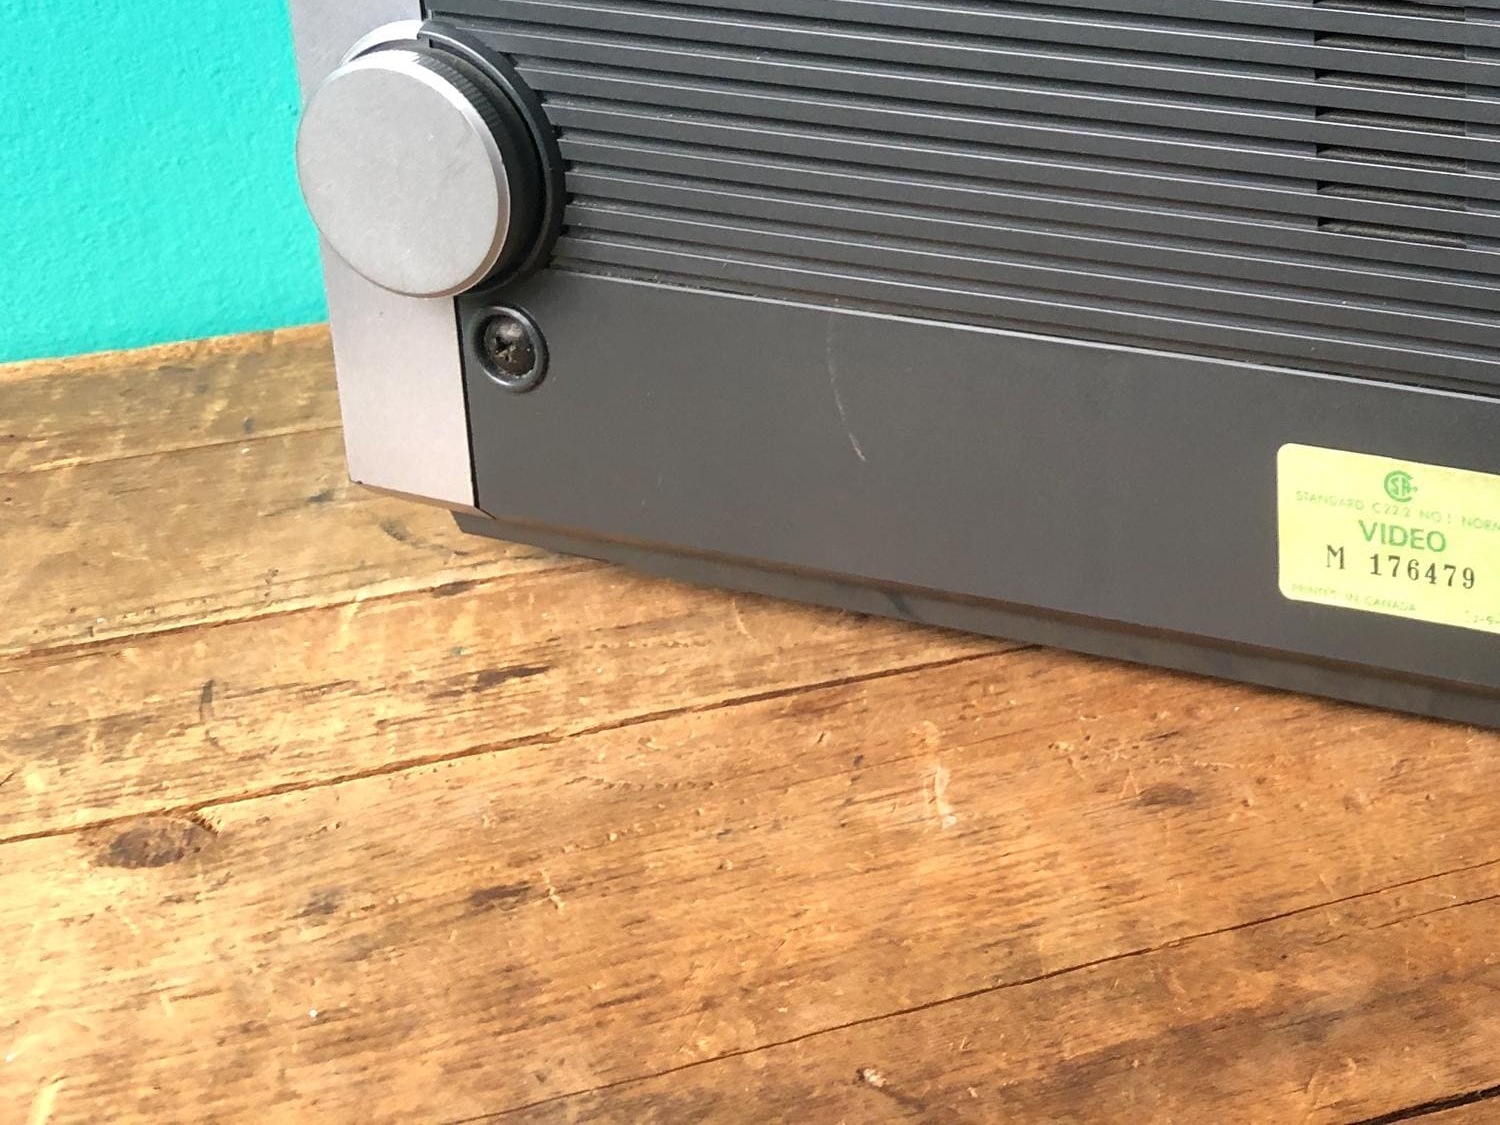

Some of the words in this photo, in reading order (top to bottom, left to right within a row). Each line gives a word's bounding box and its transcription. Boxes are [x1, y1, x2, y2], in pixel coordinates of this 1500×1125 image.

[1358, 519, 1447, 553] VIDEO
[1326, 544, 1345, 569] M
[1370, 553, 1475, 589] 176479
